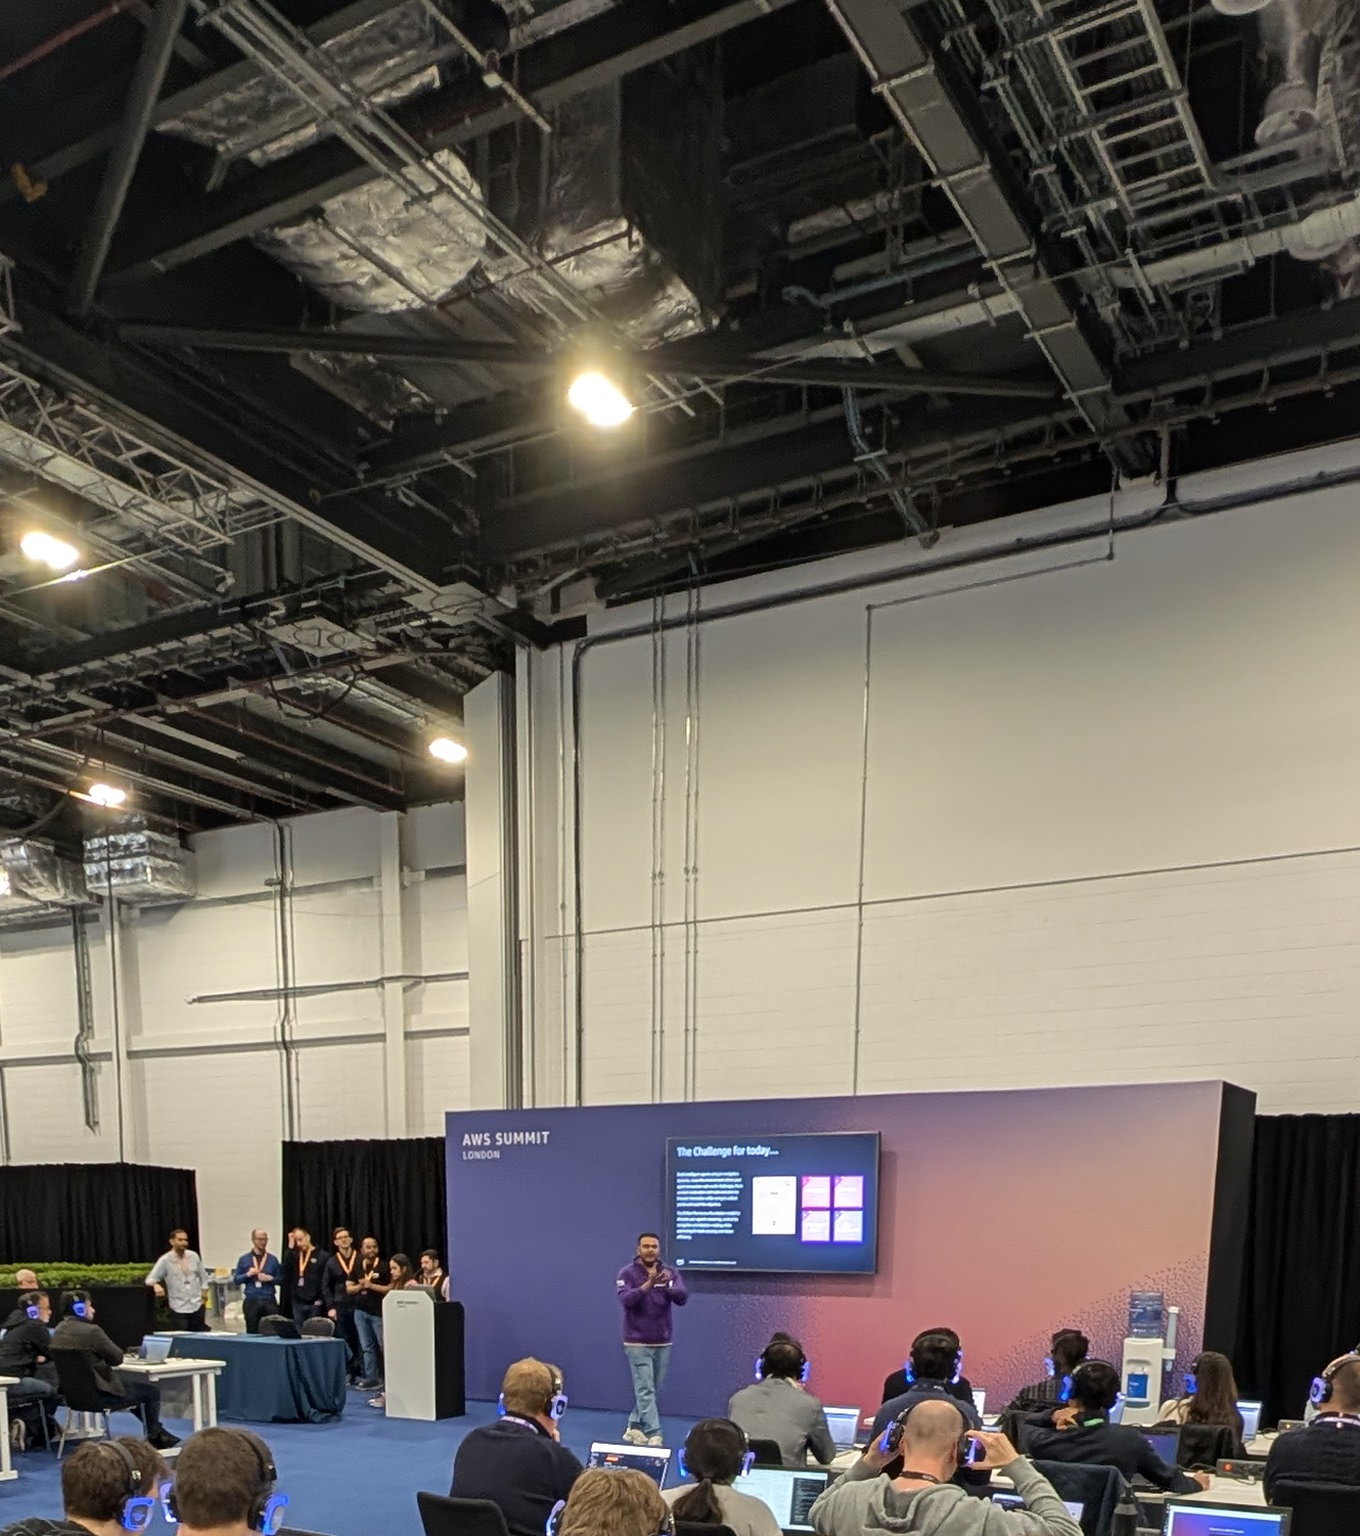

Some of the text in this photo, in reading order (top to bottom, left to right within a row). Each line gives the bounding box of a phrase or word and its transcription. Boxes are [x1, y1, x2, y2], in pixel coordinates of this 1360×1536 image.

[463, 1131, 550, 1146] AWS SUMMIT
[463, 1150, 500, 1160] LONDON
[677, 1146, 692, 1157] The
[693, 1145, 732, 1158] Challenge
[733, 1145, 746, 1156] for
